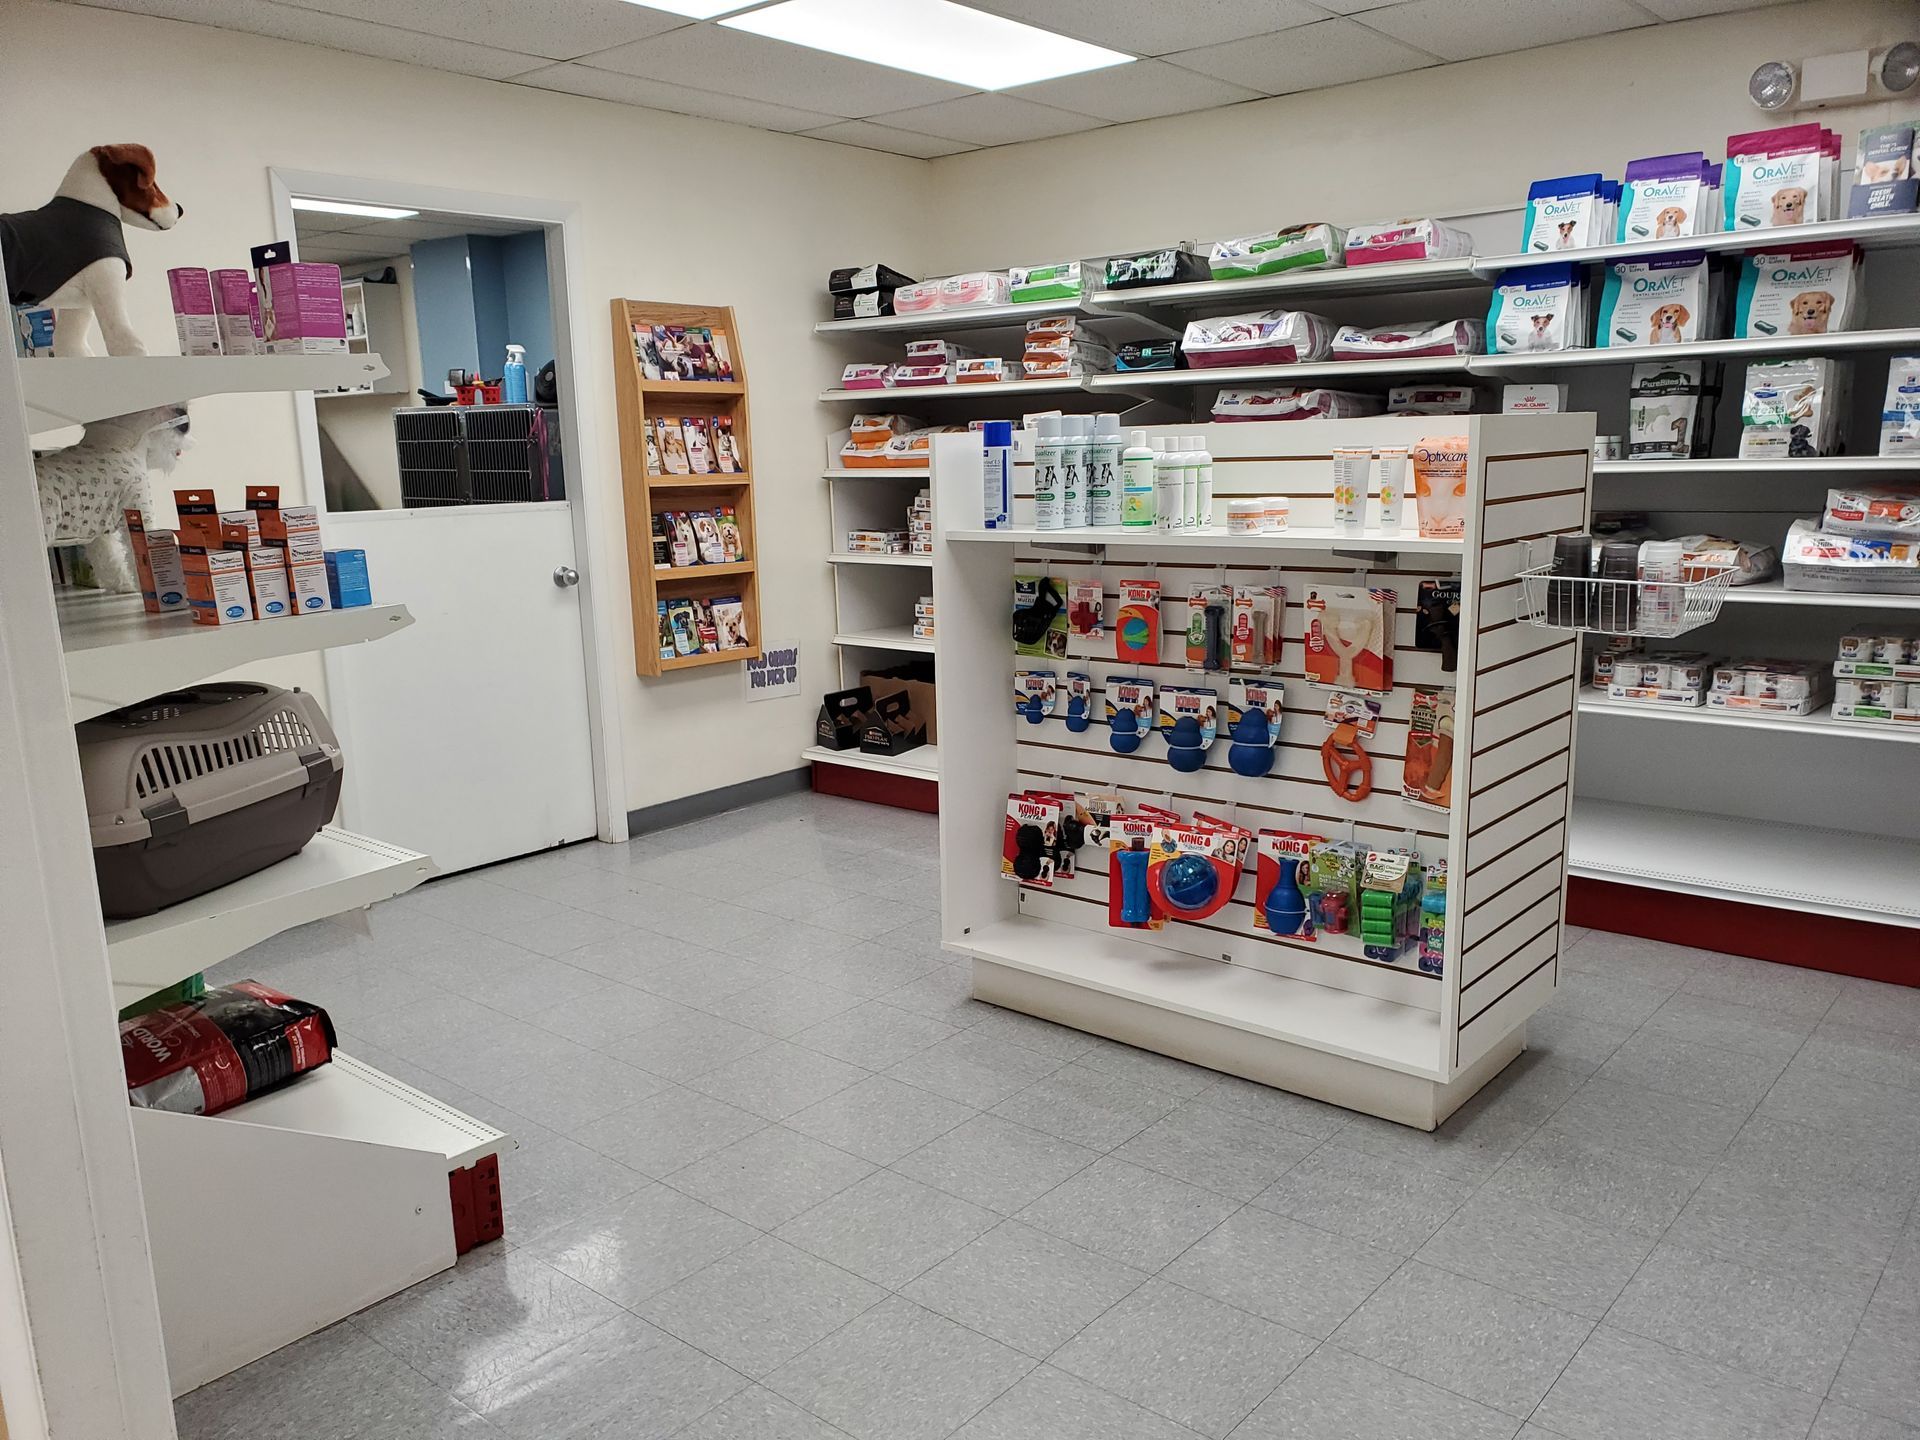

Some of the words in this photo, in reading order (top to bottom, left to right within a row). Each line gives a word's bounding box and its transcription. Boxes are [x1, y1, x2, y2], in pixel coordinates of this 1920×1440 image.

[1754, 256, 1766, 266] 30
[1615, 265, 1627, 274] 30
[1128, 589, 1146, 599] KONG
[1432, 590, 1461, 600] GOUR
[786, 667, 797, 683] UP
[1018, 803, 1040, 816] KONG
[1019, 813, 1044, 821] DENTAL
[1123, 823, 1146, 833] KONG
[1178, 833, 1203, 846] KONG
[1272, 838, 1300, 853] KONG
[133, 1028, 171, 1063] WORLD
